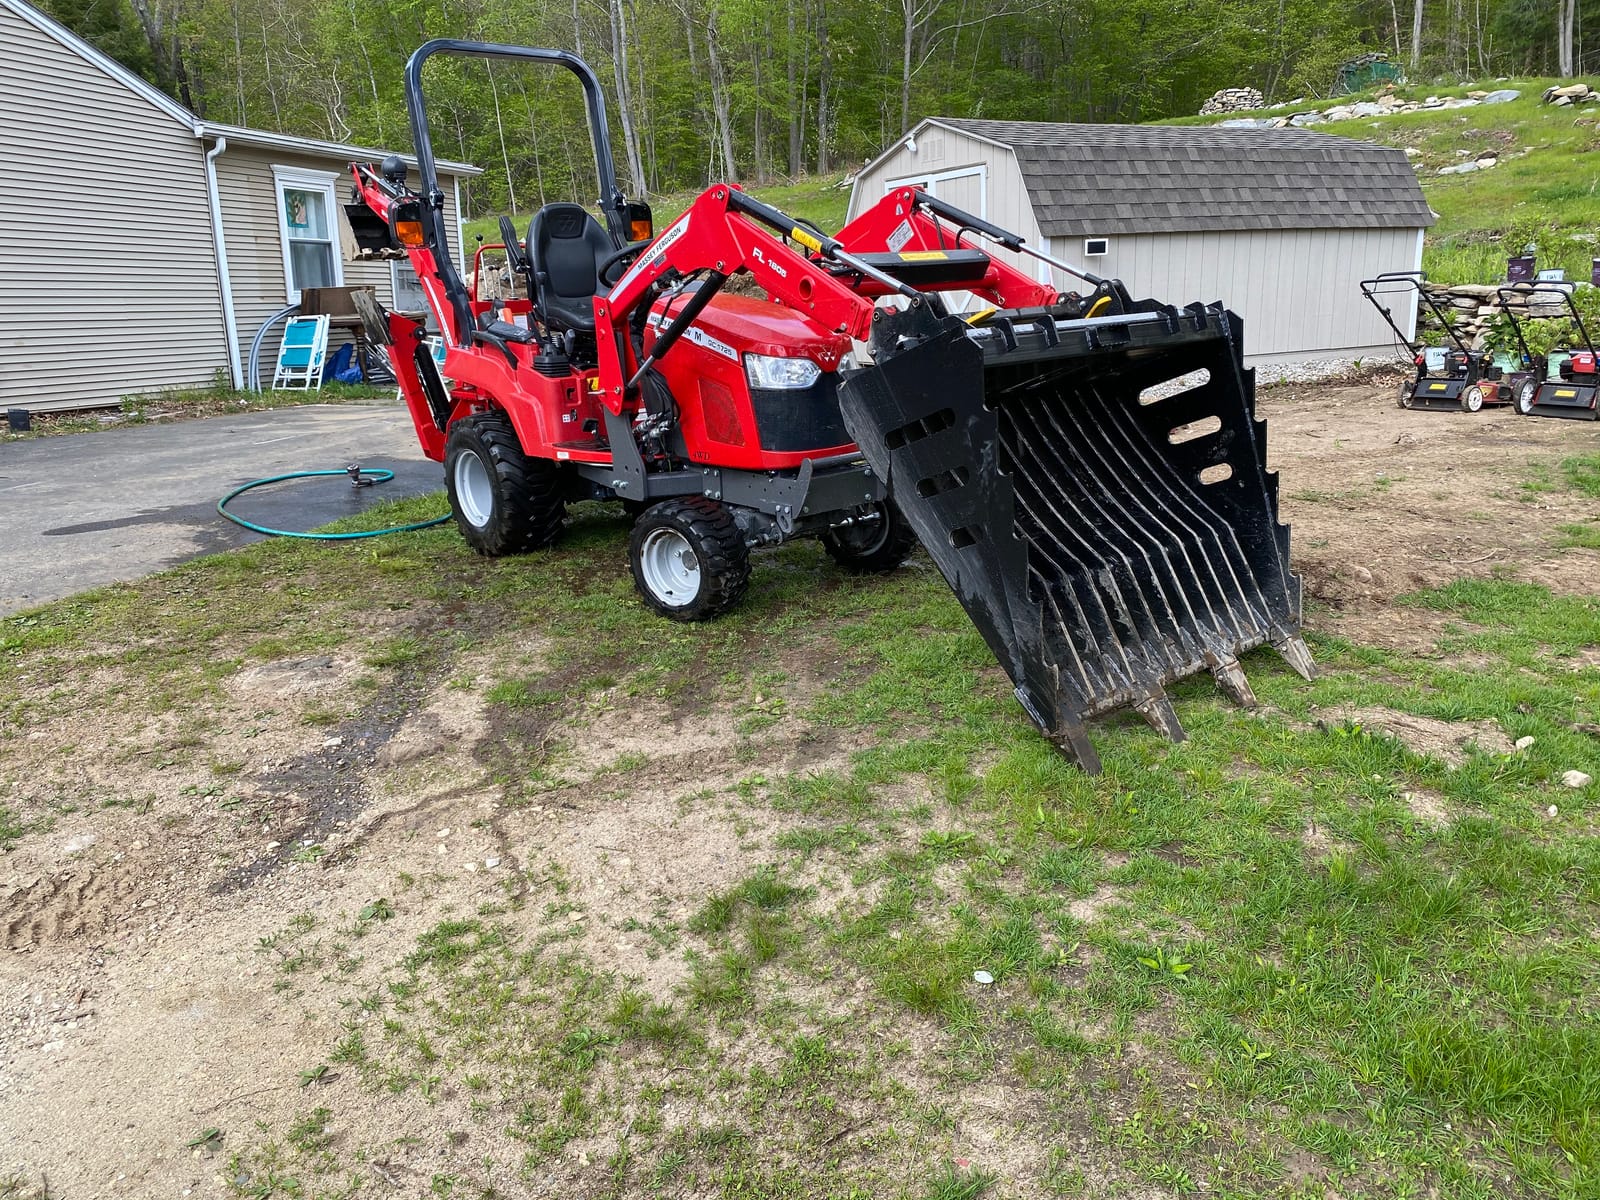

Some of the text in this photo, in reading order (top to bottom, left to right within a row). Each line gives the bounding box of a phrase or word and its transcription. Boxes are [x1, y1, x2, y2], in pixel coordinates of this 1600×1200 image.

[637, 249, 656, 271] MASSEY
[655, 226, 681, 252] FERGUSON
[752, 247, 765, 265] FL
[694, 331, 702, 343] M
